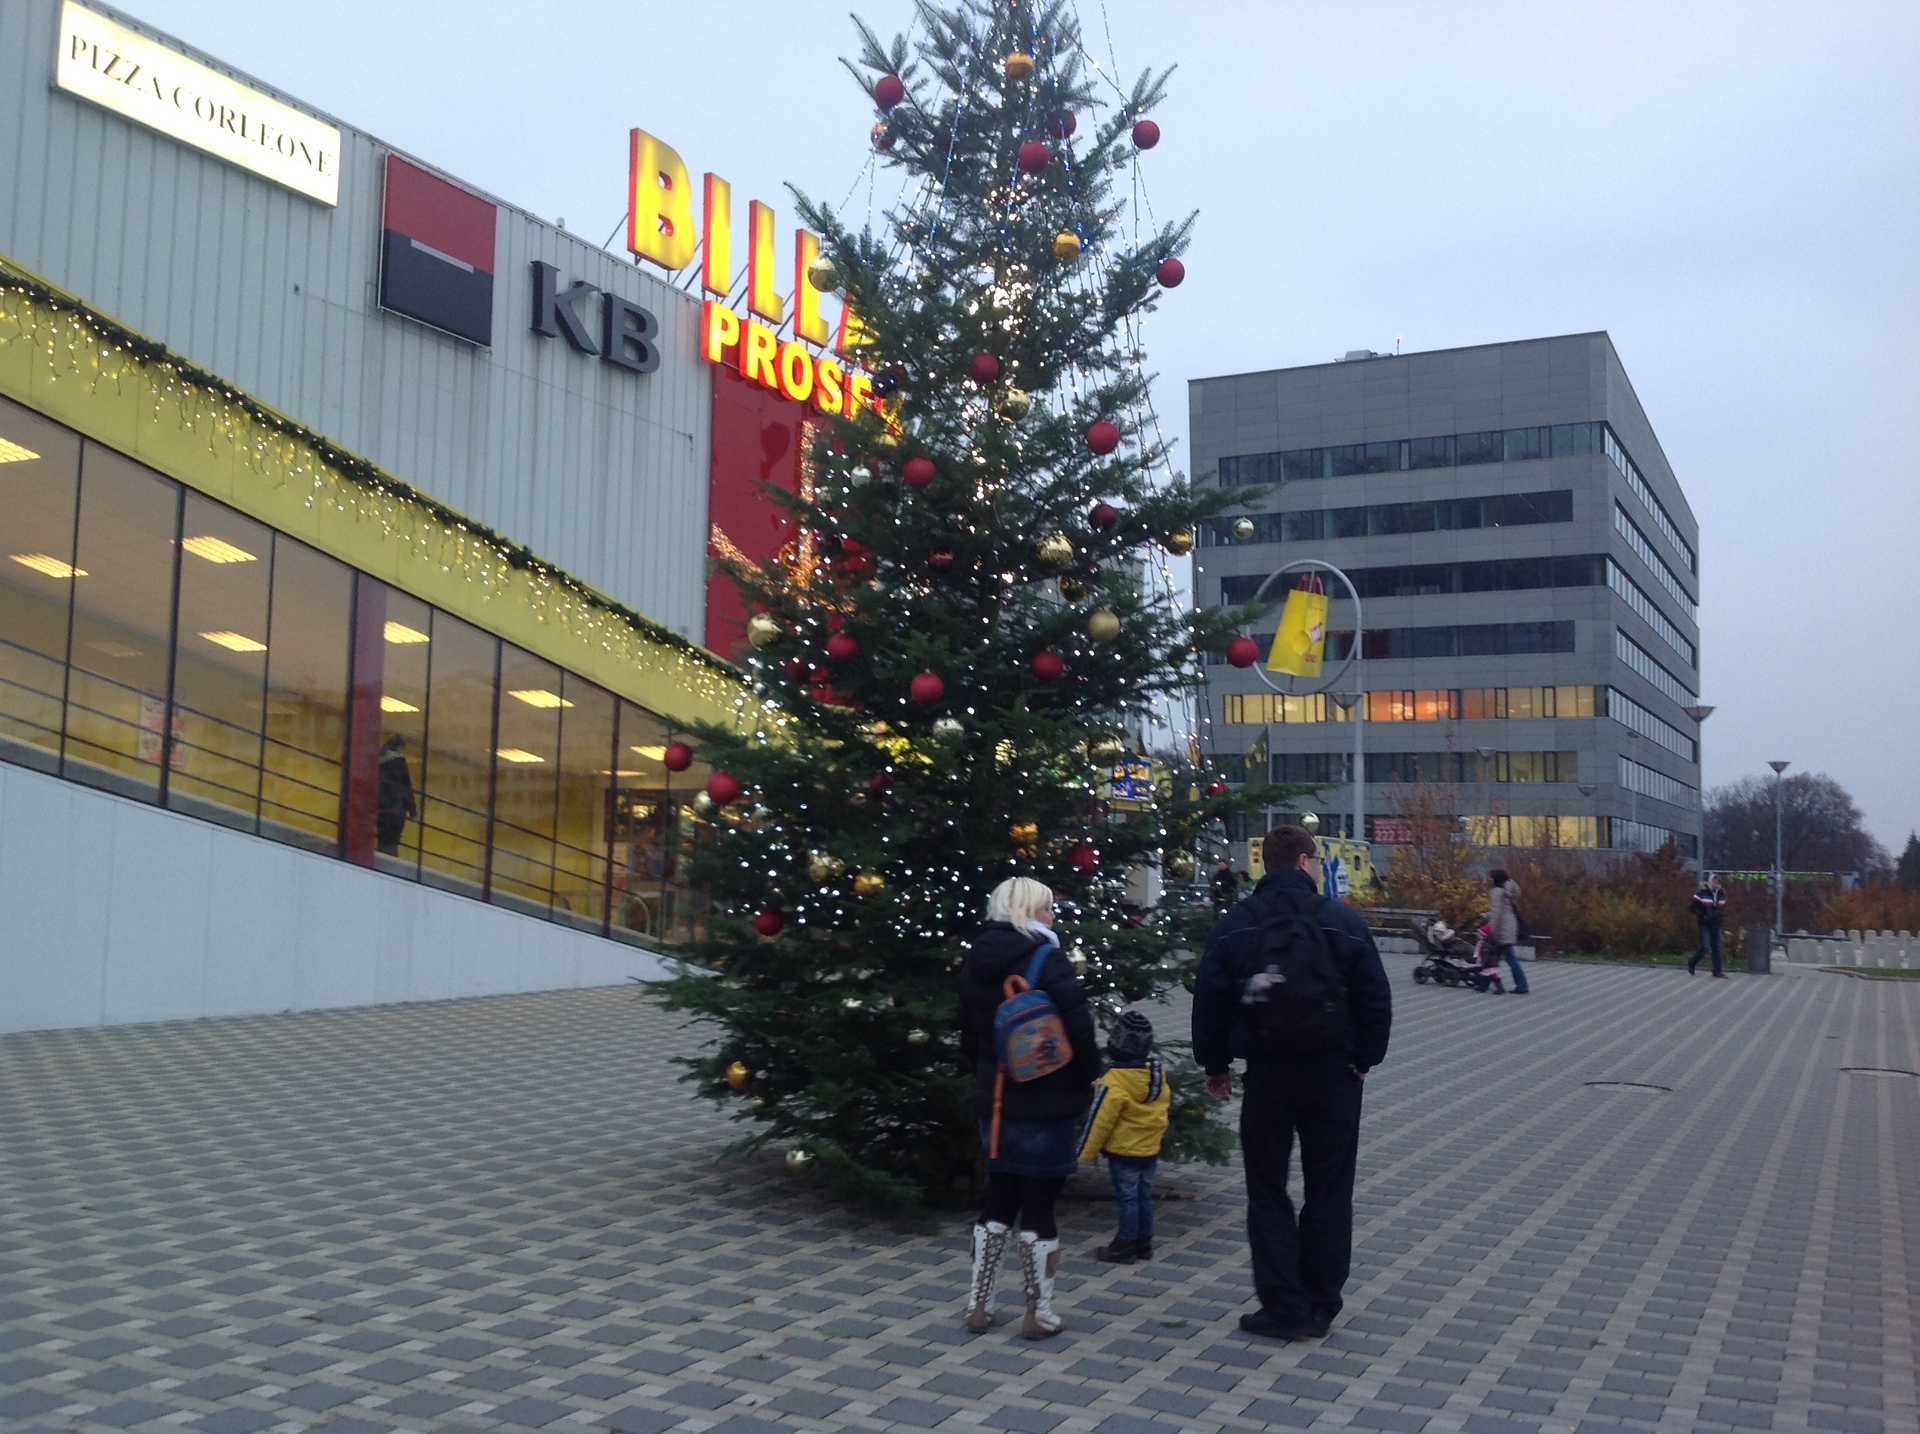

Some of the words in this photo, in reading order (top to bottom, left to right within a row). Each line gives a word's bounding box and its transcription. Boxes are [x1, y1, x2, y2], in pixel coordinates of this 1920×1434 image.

[70, 34, 163, 101] PIZZA
[173, 85, 333, 177] CORLEONE
[529, 260, 661, 374] KB
